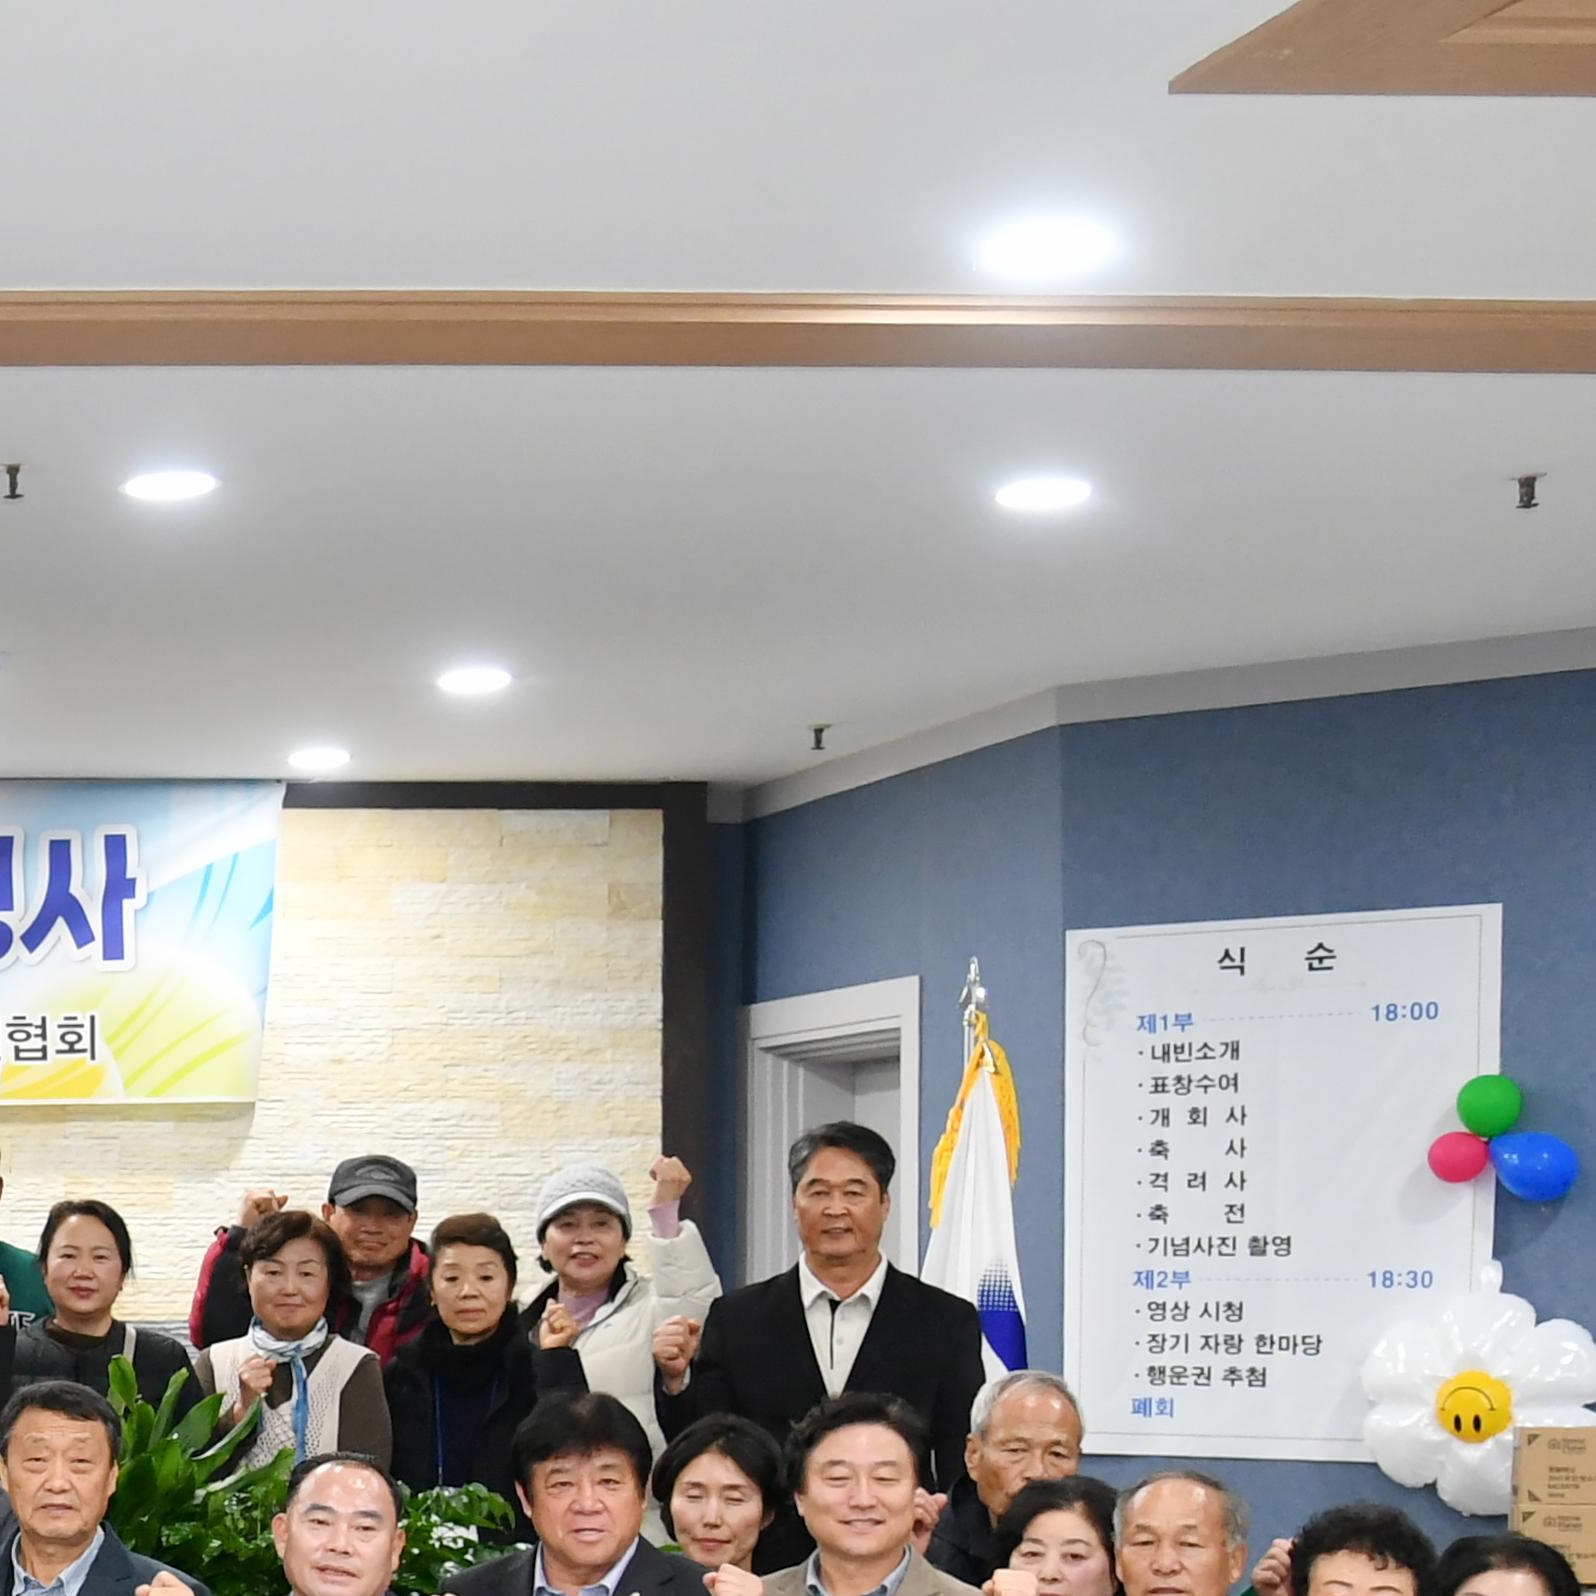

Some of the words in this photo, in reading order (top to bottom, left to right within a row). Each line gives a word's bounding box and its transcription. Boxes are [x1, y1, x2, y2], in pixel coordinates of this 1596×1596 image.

[1136, 1012, 1194, 1034] 제1부
[1371, 1002, 1440, 1023] 18:00
[1247, 1234, 1293, 1258] 촬영
[1132, 1268, 1192, 1291] 제2부
[1367, 1269, 1435, 1290] 18:30
[1198, 1299, 1245, 1324] 시청
[1198, 1332, 1246, 1357] 자랑
[1254, 1332, 1324, 1358] 한마당
[1220, 1365, 1268, 1389] 추첨
[1130, 1396, 1175, 1419] 폐회
